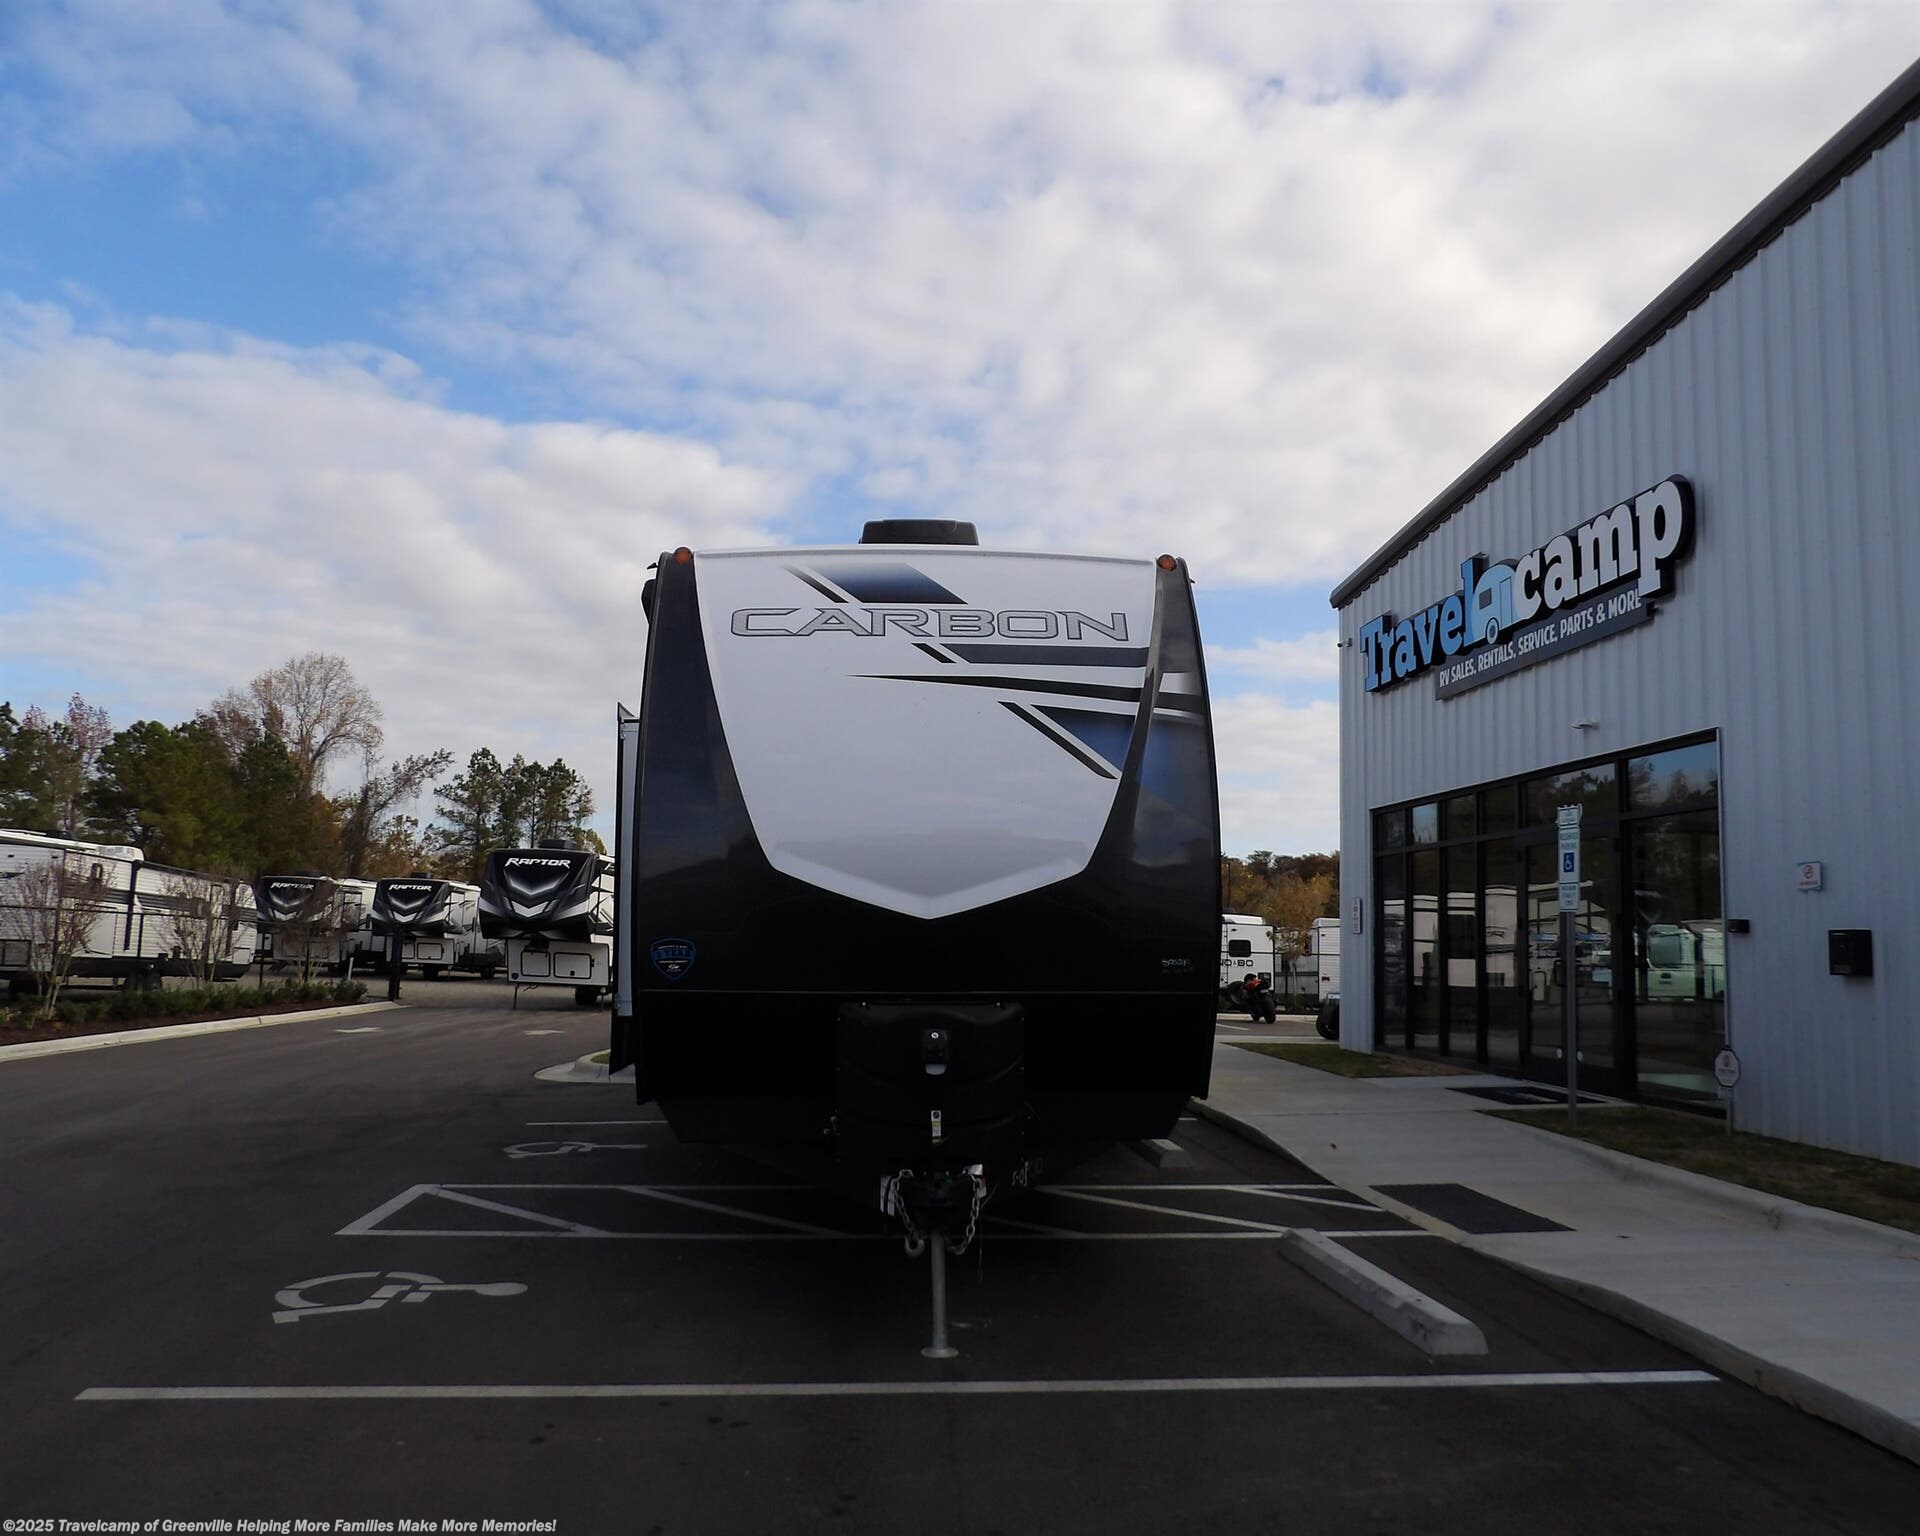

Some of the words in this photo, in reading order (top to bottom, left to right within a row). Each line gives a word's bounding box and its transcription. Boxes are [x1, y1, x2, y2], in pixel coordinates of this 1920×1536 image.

[731, 607, 1129, 642] CARBON
[1440, 668, 1451, 688] RV
[1451, 658, 1477, 683] SALES,
[1478, 641, 1517, 672] RENTALS,
[1518, 624, 1558, 655] SERVICE,
[1560, 607, 1594, 639] PARTS
[1596, 602, 1606, 624] &
[1608, 588, 1642, 619] MORE
[504, 857, 571, 869] RAPTOR
[270, 881, 315, 891] RAPTOR
[388, 882, 432, 892] RAPTOR
